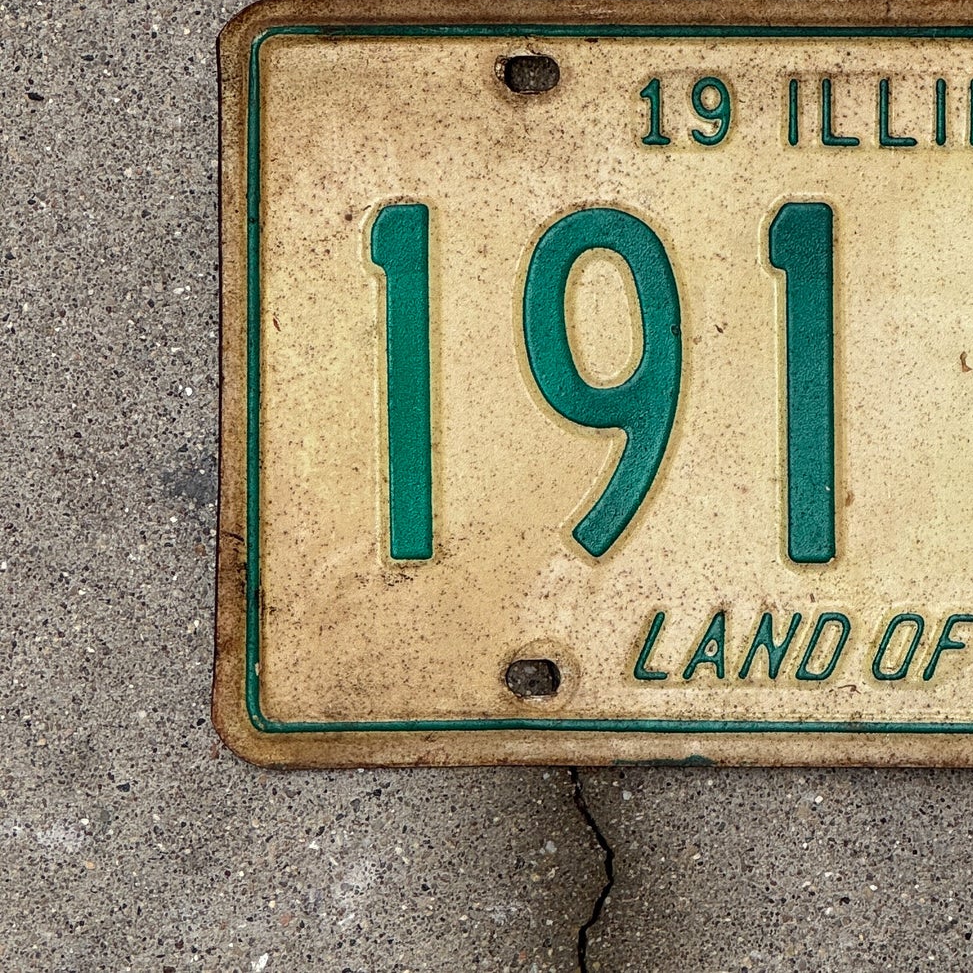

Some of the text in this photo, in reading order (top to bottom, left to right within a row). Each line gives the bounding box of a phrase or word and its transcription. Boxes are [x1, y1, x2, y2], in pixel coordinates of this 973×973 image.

[640, 77, 731, 146] 19
[370, 202, 836, 564] 191
[635, 612, 851, 681] LAND
